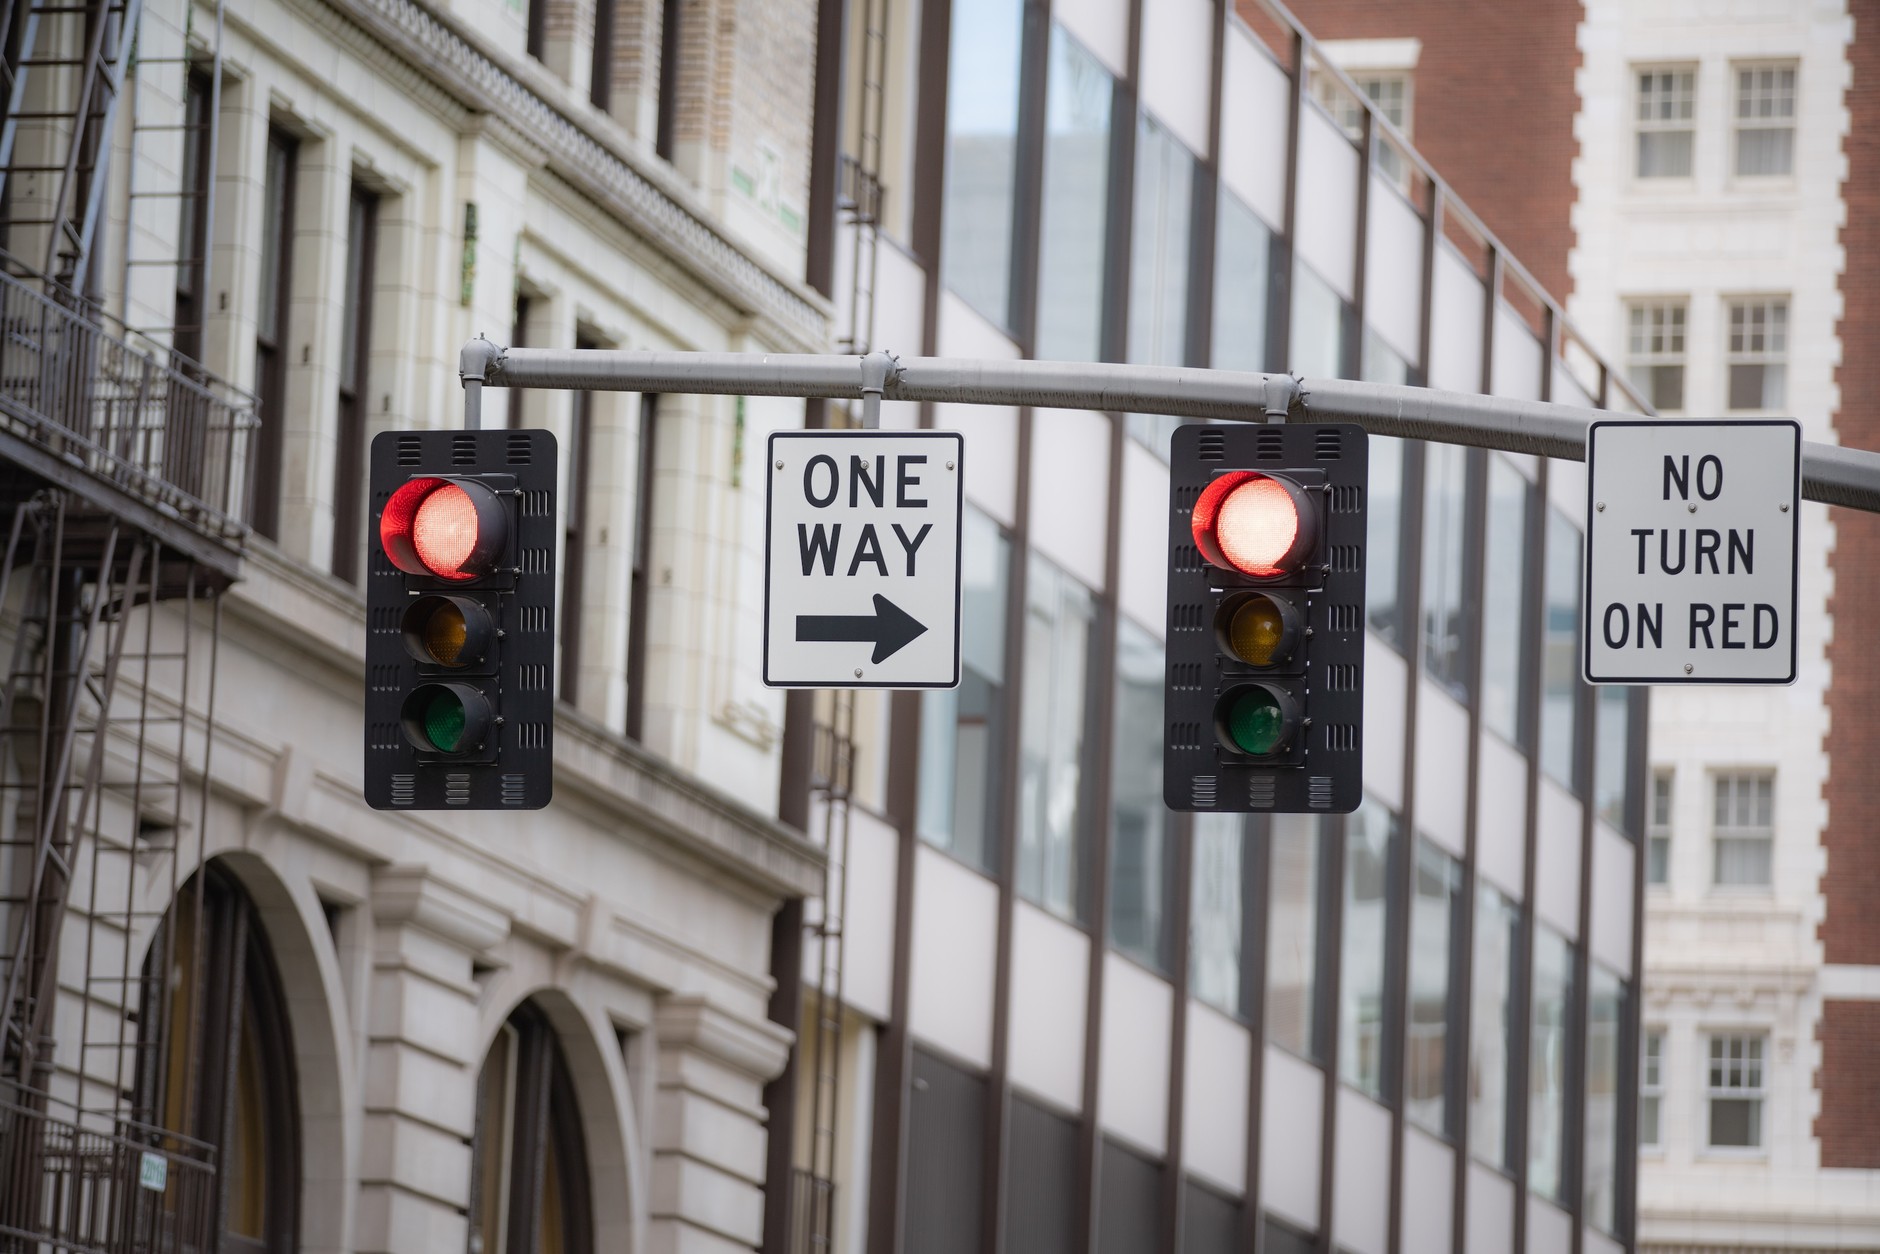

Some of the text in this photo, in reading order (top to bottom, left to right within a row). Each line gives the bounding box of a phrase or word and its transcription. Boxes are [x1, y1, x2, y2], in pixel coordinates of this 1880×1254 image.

[803, 454, 928, 509] ONE
[1662, 454, 1724, 502] NO
[796, 523, 934, 577] WAY
[1630, 528, 1754, 576] TURN
[1602, 602, 1779, 650] ON RED
